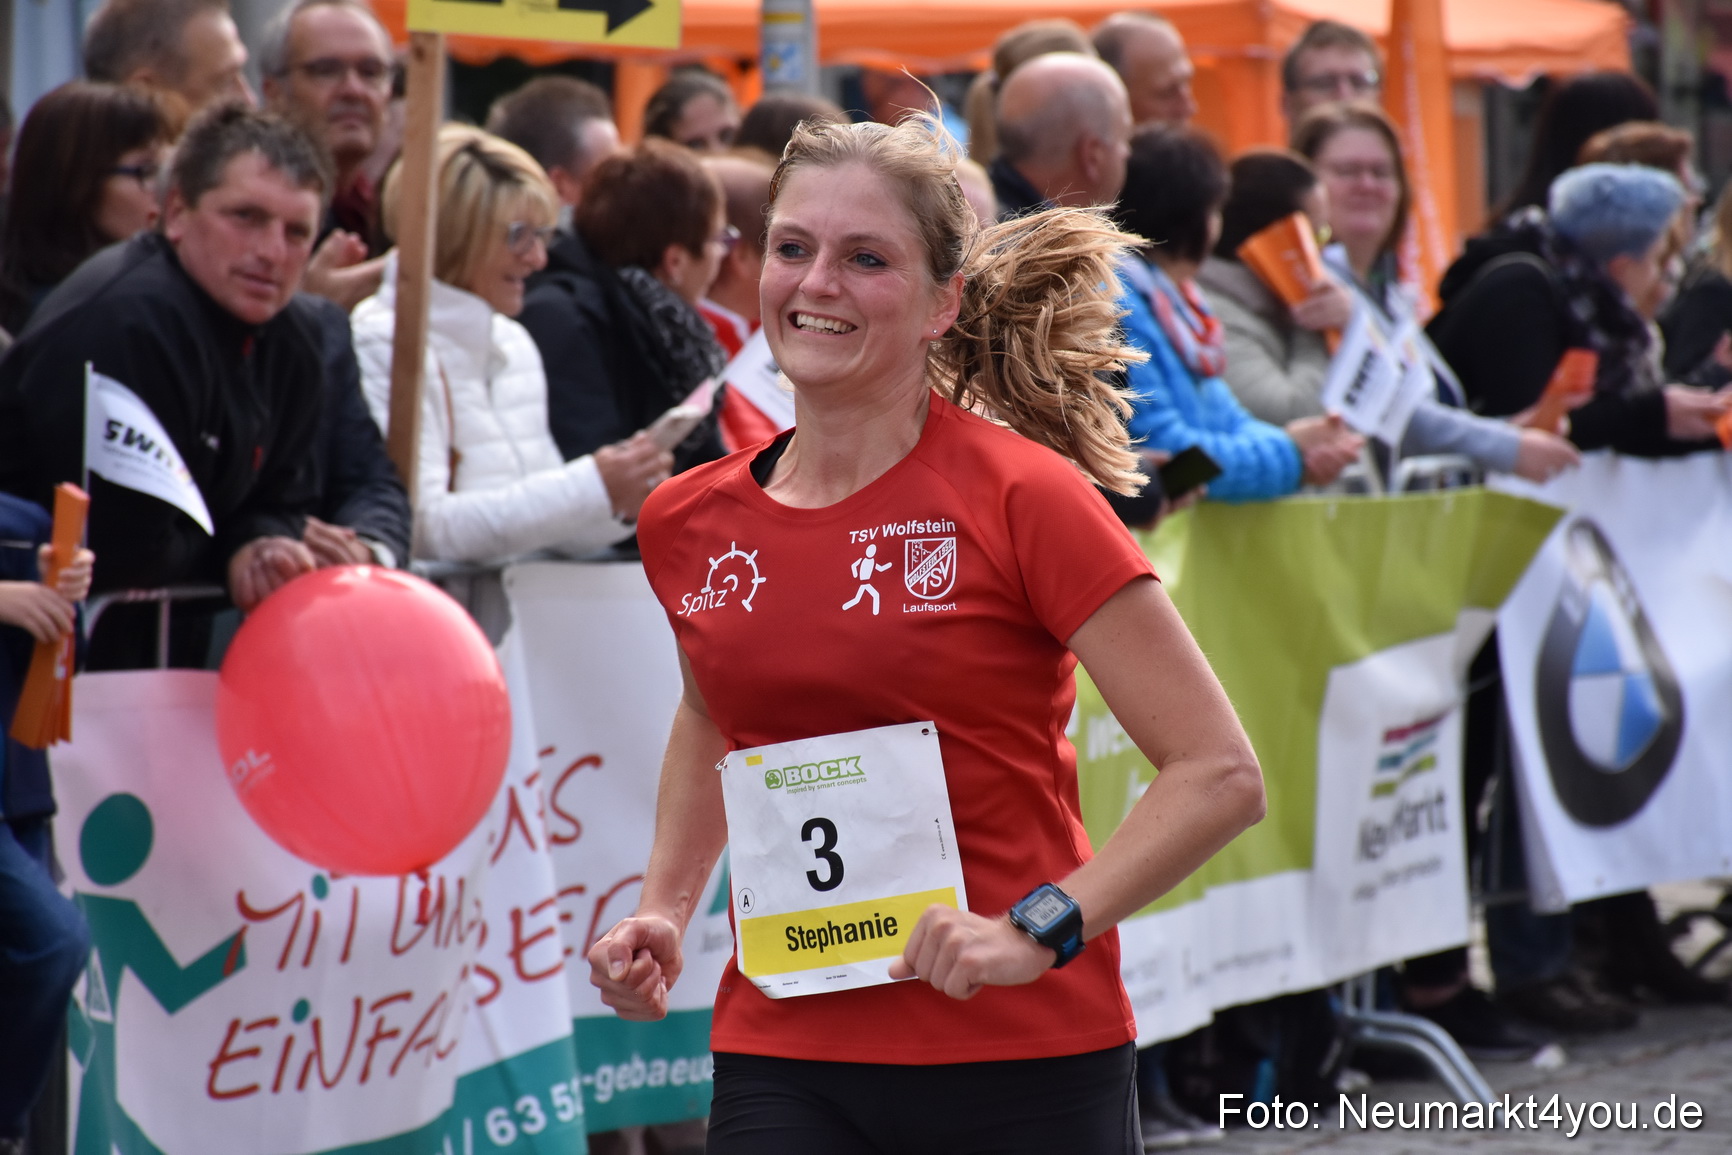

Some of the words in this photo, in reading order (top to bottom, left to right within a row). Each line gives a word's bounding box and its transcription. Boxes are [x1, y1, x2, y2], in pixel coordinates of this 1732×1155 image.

[849, 526, 879, 544] TSV
[882, 518, 956, 538] Wolfstein
[920, 552, 953, 596] TSV
[677, 588, 728, 617] Spitz
[903, 602, 957, 613] Laufsport
[783, 755, 865, 787] BOCK
[786, 786, 807, 795] inspired
[808, 784, 815, 792] by
[817, 782, 836, 790] smart
[837, 777, 867, 787] concepts
[801, 817, 844, 892] 3
[743, 894, 750, 908] A
[785, 912, 898, 953] Stephanie
